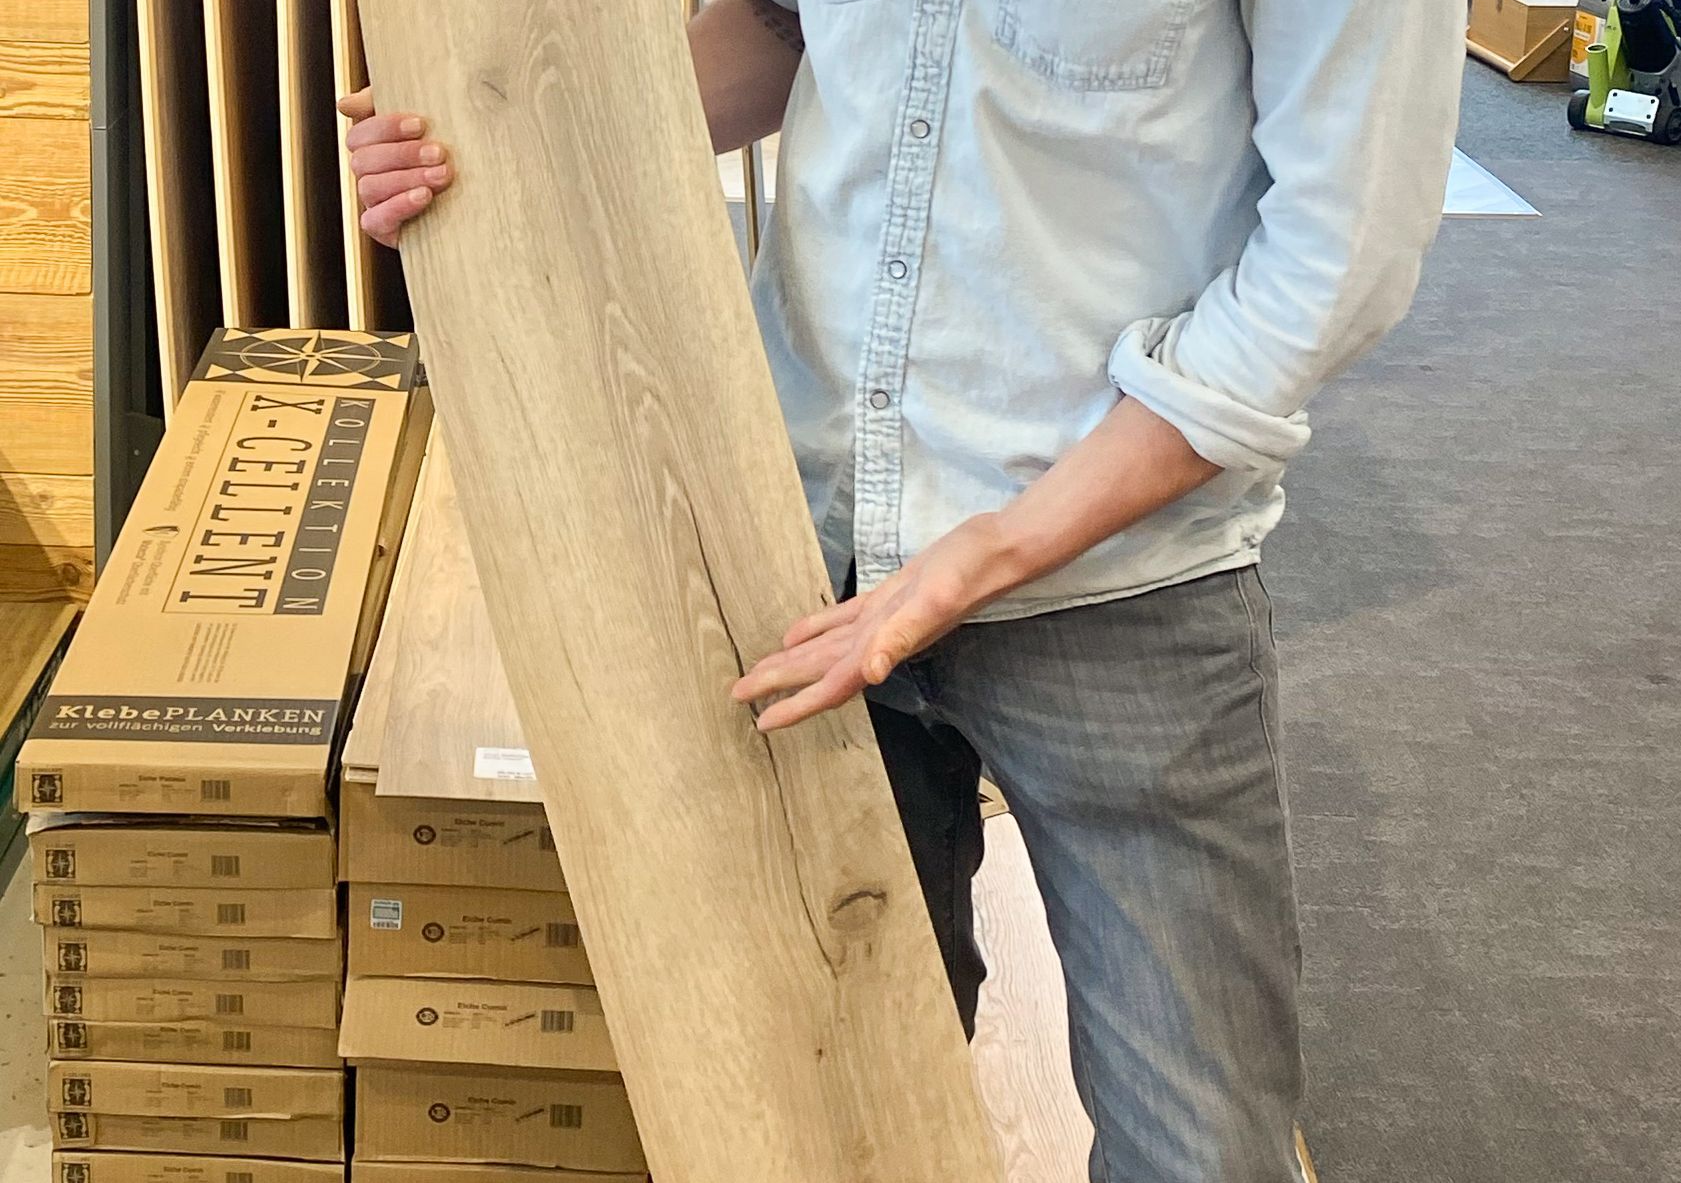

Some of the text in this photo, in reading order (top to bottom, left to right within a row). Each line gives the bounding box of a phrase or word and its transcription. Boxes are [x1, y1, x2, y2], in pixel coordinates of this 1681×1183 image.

[179, 394, 326, 609] X-CELLENT
[282, 399, 370, 610] KOLLEKTION
[48, 720, 323, 736] zur vollflächigen Verklebung
[55, 705, 326, 724] KlebePLANKEN
